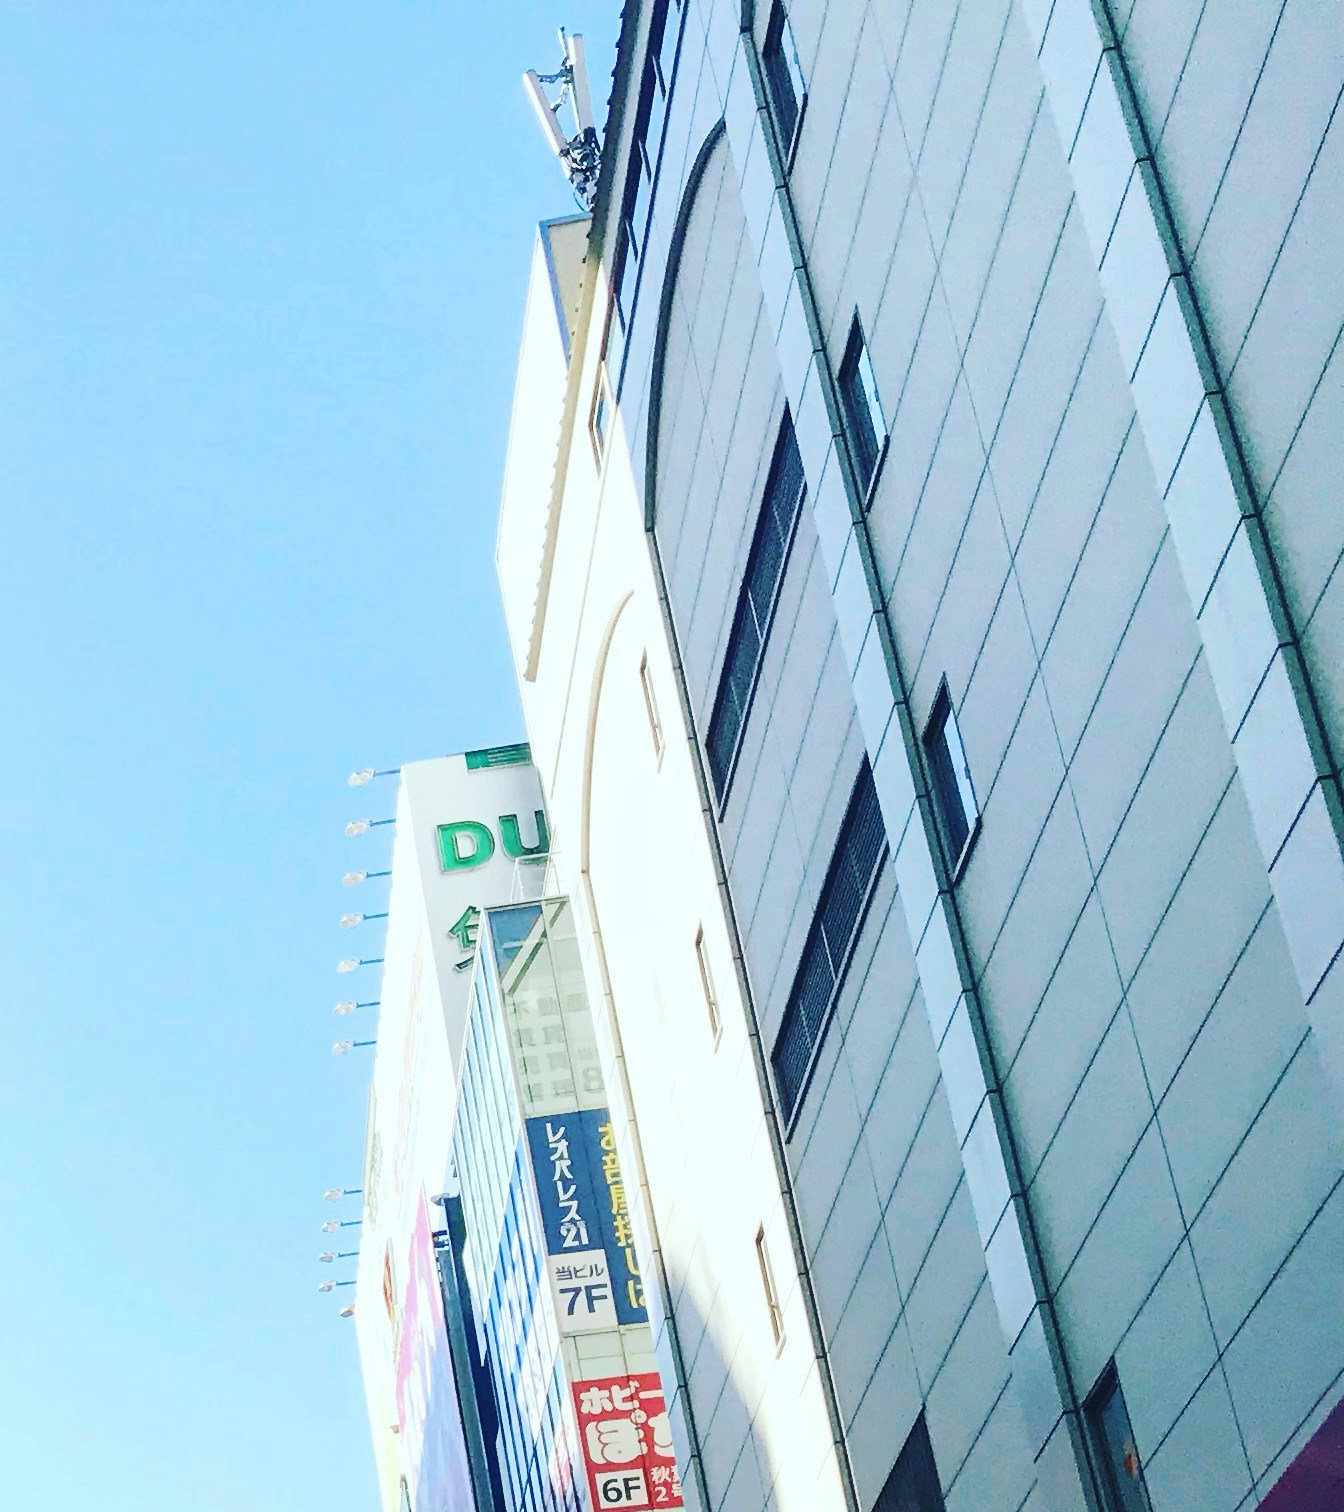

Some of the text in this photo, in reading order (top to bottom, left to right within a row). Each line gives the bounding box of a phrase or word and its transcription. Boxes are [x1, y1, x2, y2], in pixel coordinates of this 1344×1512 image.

[544, 1121, 590, 1249] レオパレス21
[554, 1262, 605, 1282] 当ビル
[558, 1282, 609, 1317] 7F
[579, 1378, 664, 1415] ホビー
[602, 1476, 642, 1503] 6F
